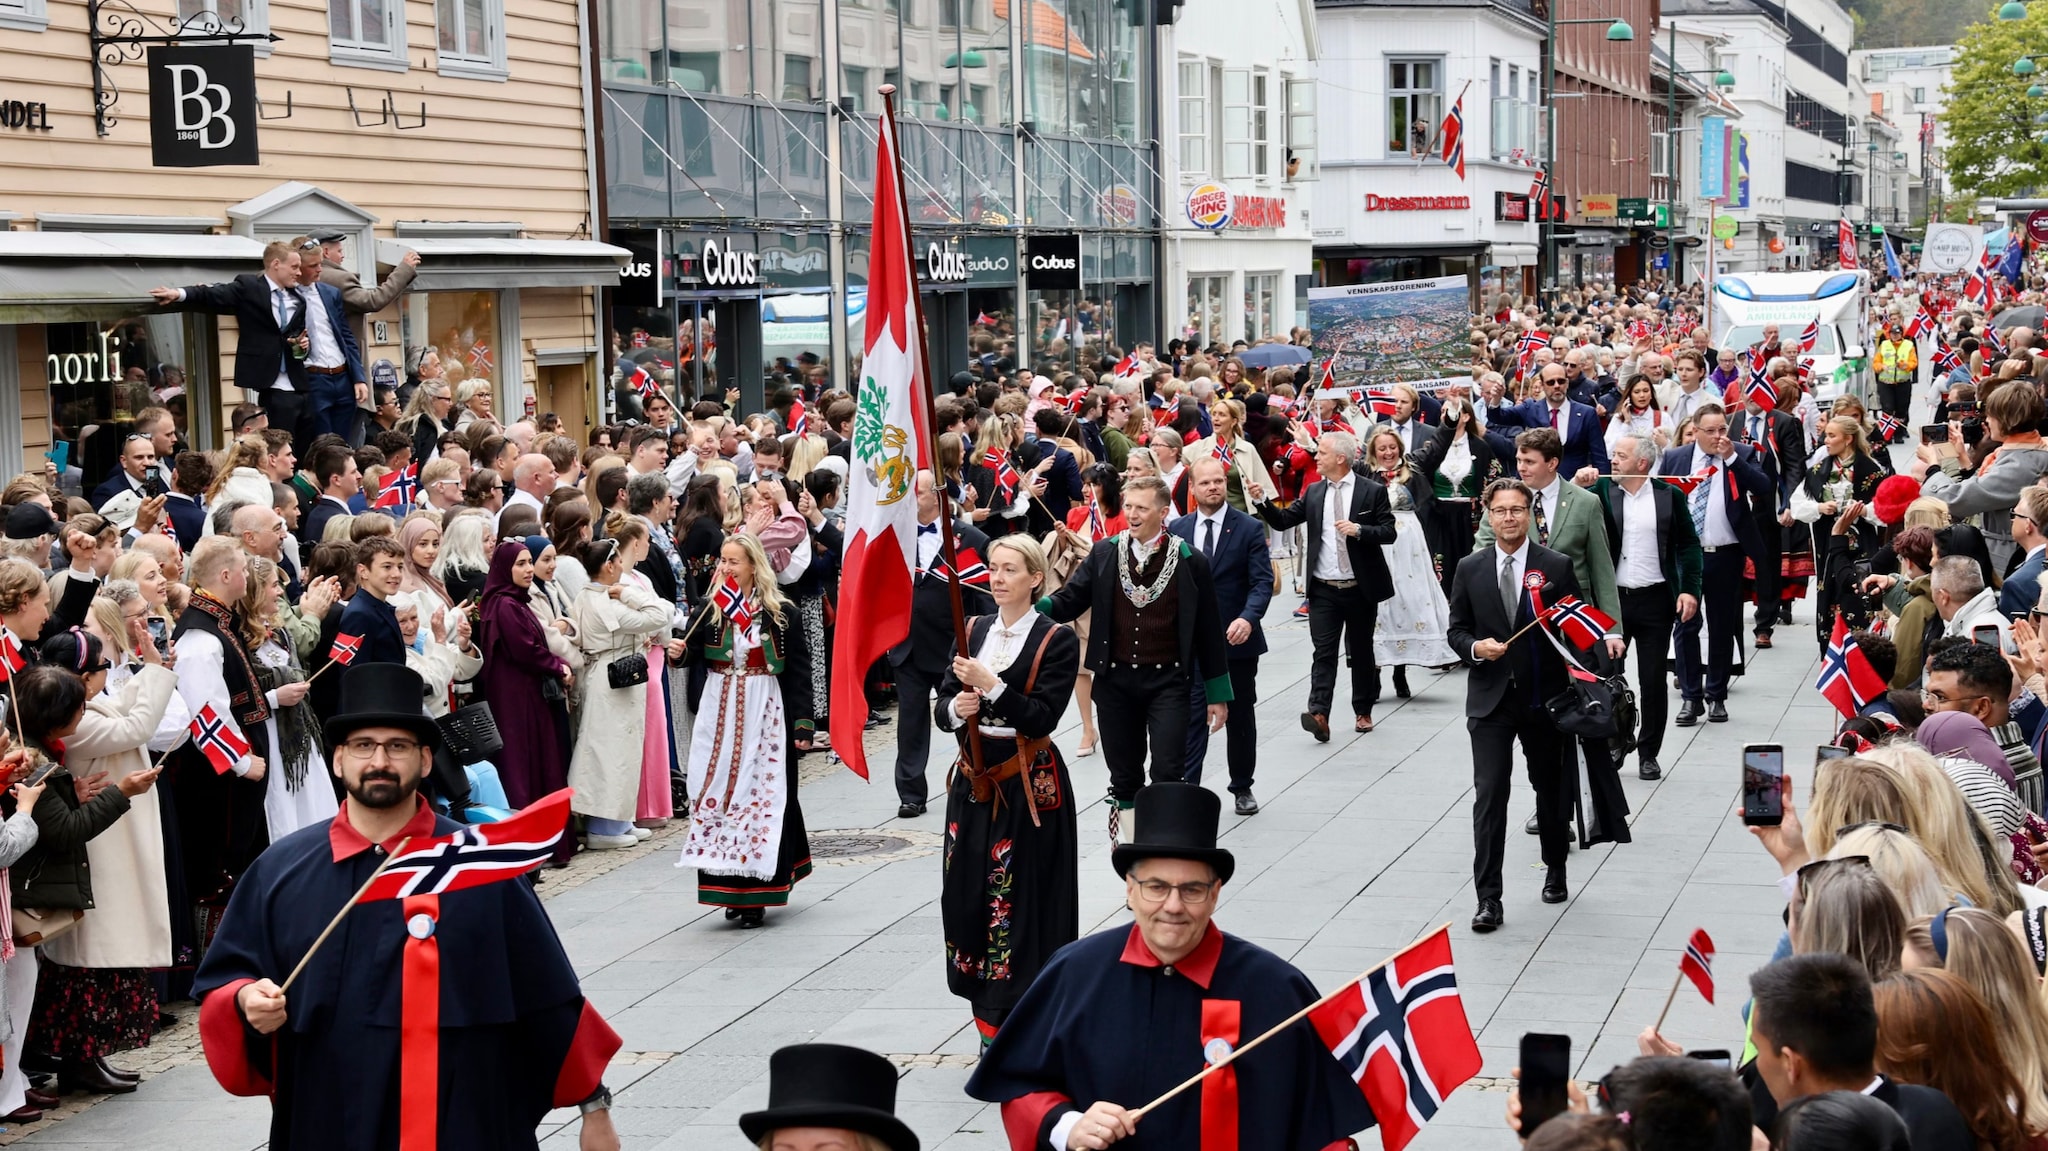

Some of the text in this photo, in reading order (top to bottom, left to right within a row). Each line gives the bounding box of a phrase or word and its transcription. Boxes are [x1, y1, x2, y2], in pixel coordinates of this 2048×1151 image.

[177, 131, 199, 141] 1860
[1190, 191, 1225, 207] BURGER
[1365, 193, 1471, 212] Dressmann
[1191, 200, 1227, 219] KING
[1233, 195, 1285, 228] BURGER KING
[703, 236, 756, 285] Cubus
[928, 240, 965, 280] Cubus
[1032, 254, 1075, 270] Cubus
[1346, 281, 1436, 295] VENNSKAPSFORENING
[377, 324, 387, 341] 21
[48, 331, 123, 385] norli
